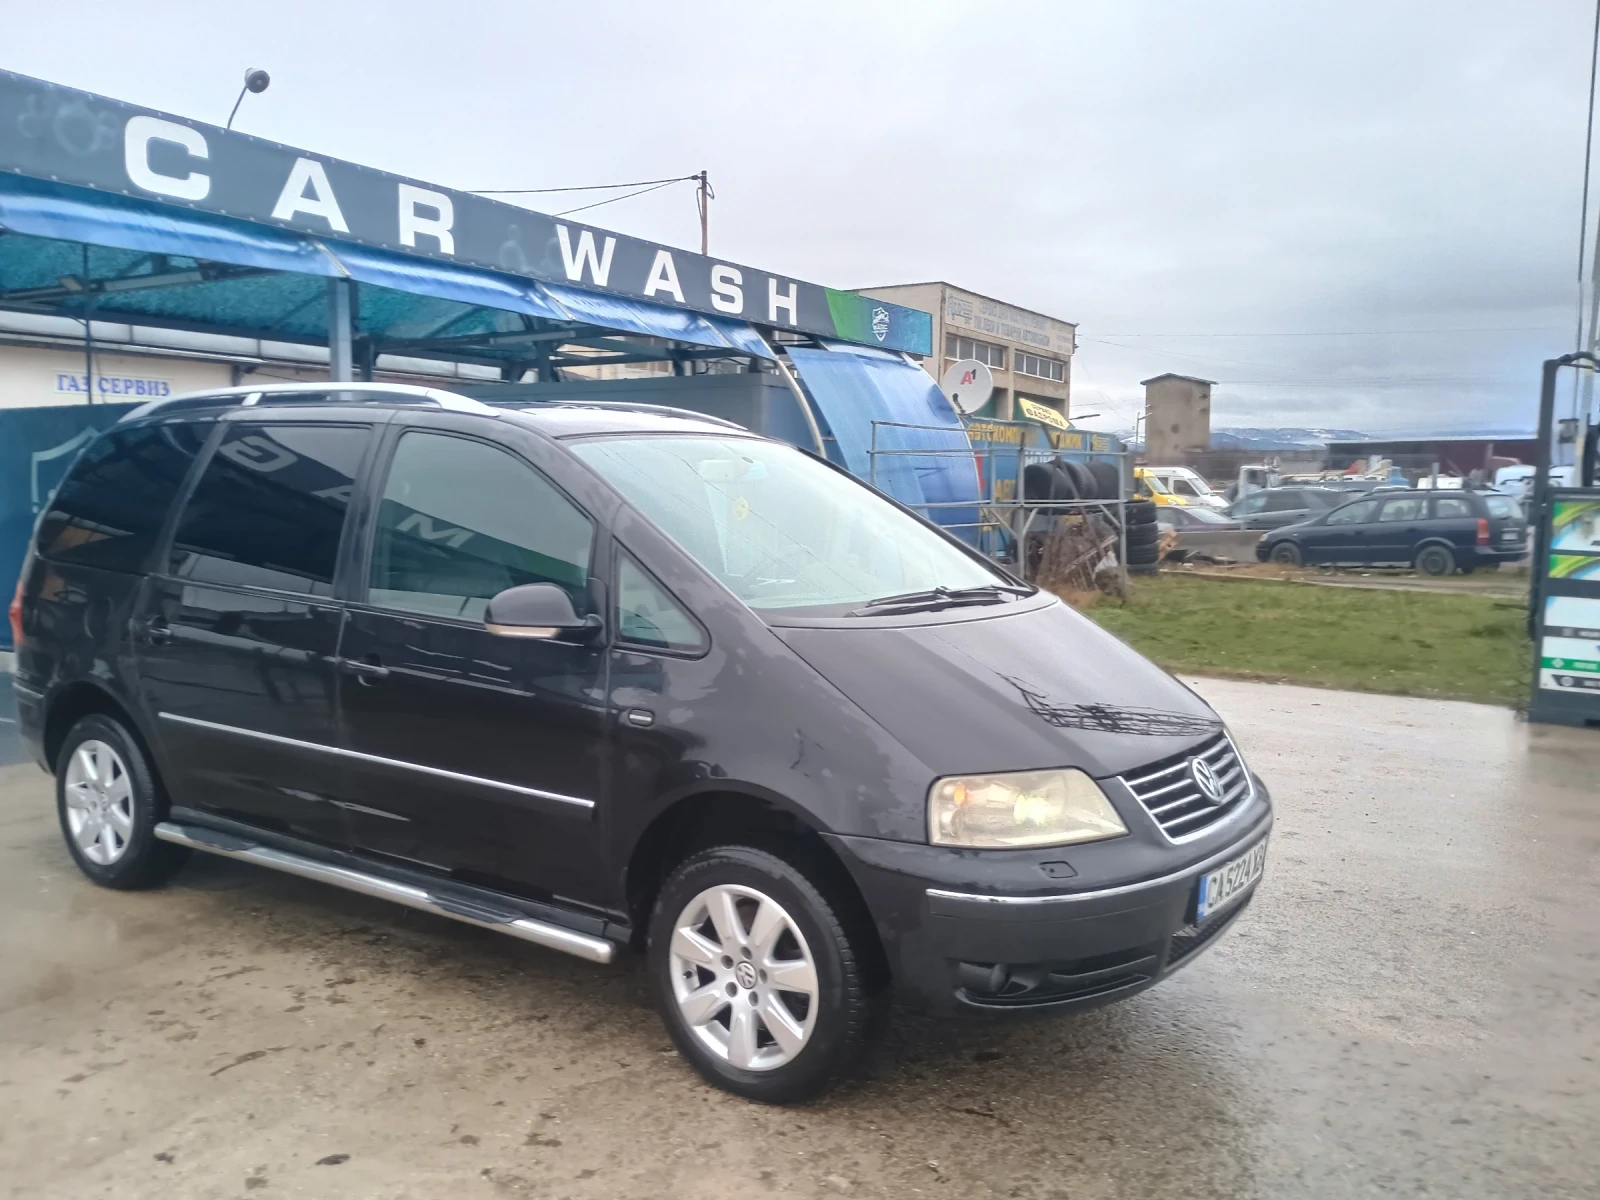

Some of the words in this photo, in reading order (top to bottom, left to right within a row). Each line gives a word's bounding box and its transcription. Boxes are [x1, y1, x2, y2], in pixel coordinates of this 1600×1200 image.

[125, 115, 455, 255] CAR
[555, 224, 798, 326] WASH
[98, 376, 170, 397] СЕРВИЗ
[960, 368, 977, 385] A1
